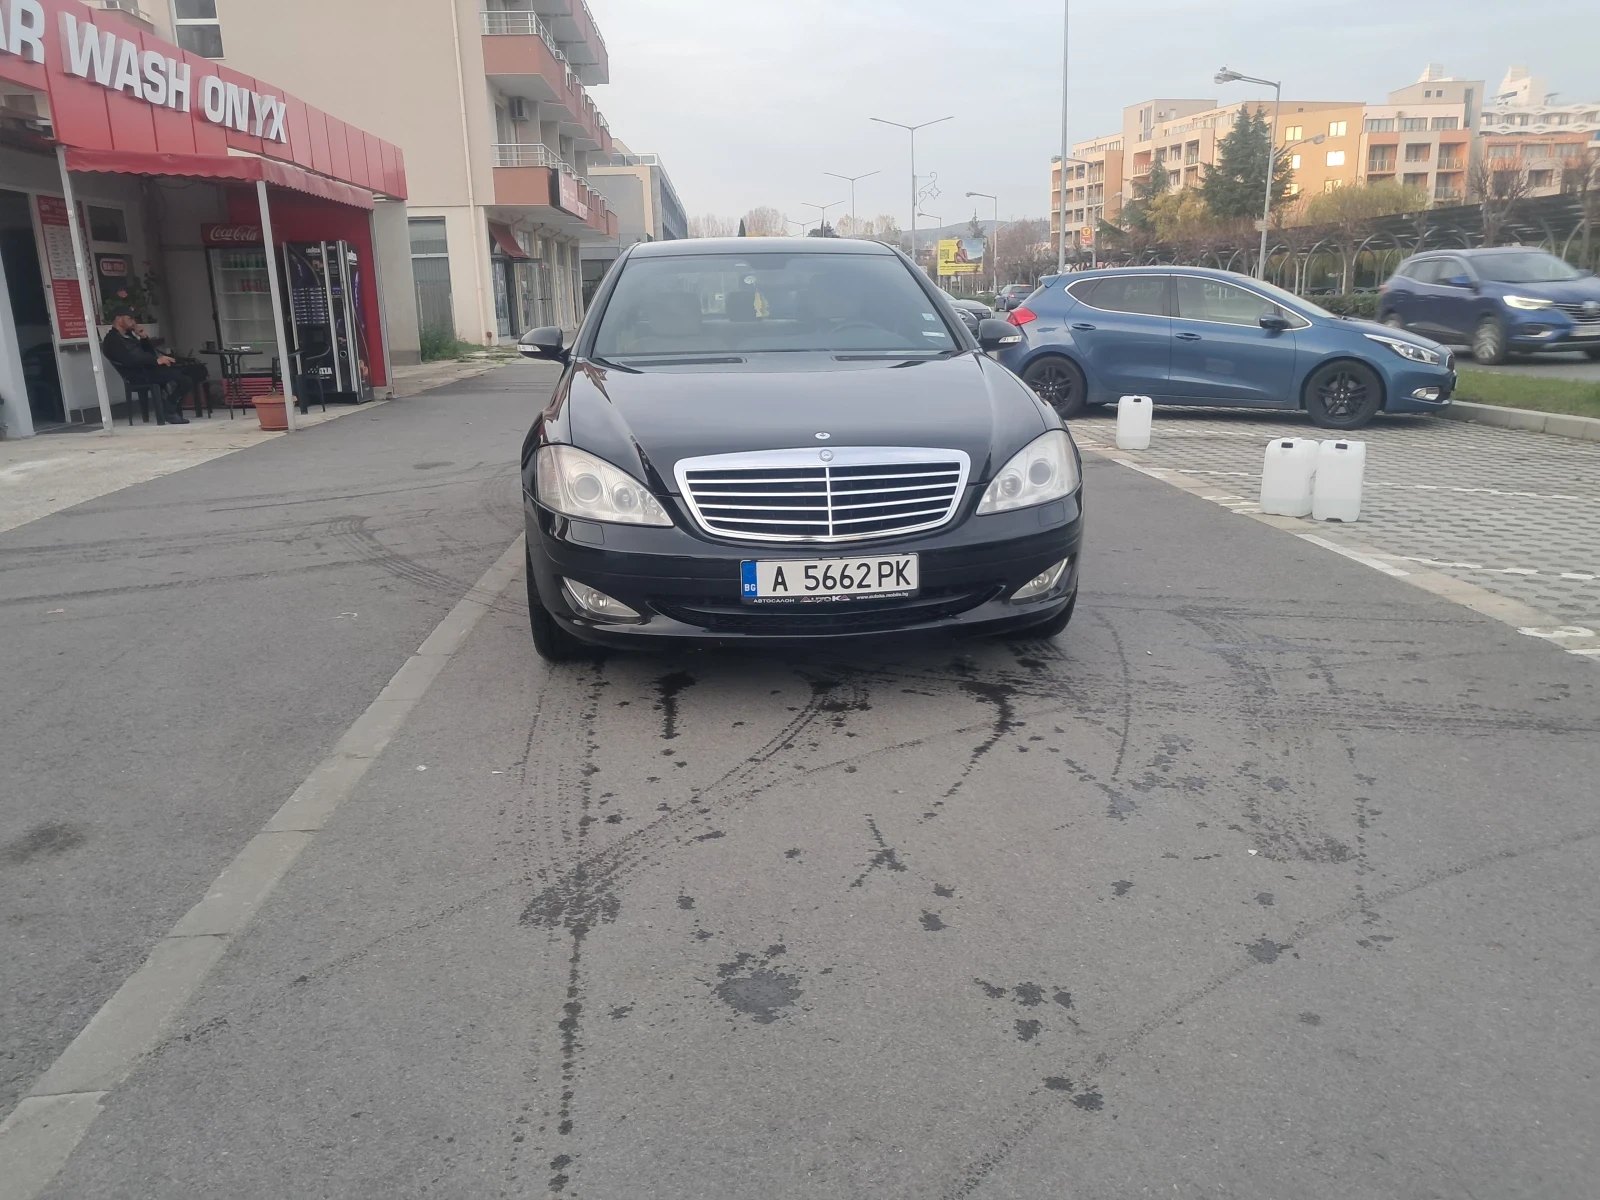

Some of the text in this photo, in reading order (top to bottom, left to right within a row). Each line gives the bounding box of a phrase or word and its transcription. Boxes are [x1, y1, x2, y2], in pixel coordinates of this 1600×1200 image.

[57, 11, 191, 113] WASH
[198, 75, 287, 144] ONYX
[744, 584, 756, 592] BG
[772, 566, 788, 592] A
